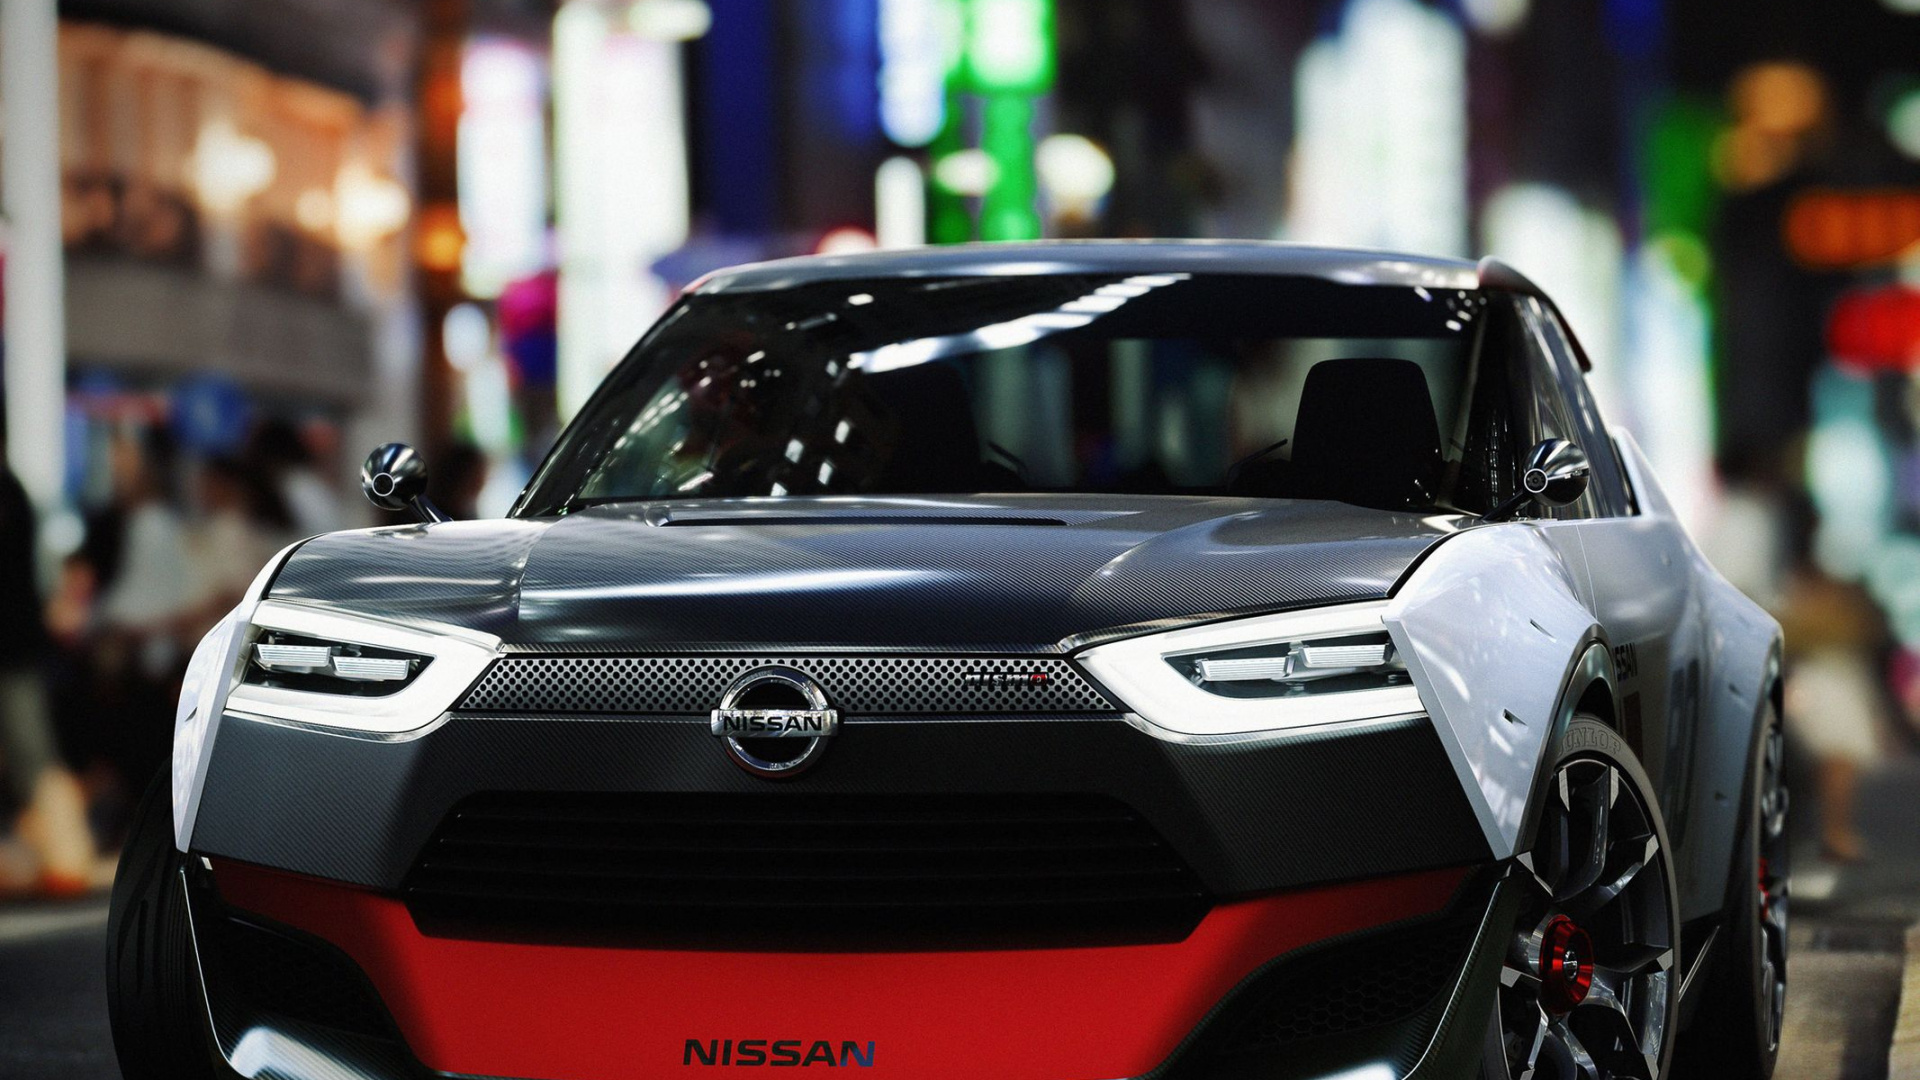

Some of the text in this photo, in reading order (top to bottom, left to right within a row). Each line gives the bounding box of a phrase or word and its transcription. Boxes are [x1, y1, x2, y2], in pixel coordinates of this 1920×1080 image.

[1612, 643, 1638, 681] SSAN
[723, 716, 822, 731] NISSAN
[683, 1039, 875, 1067] NISSAN
